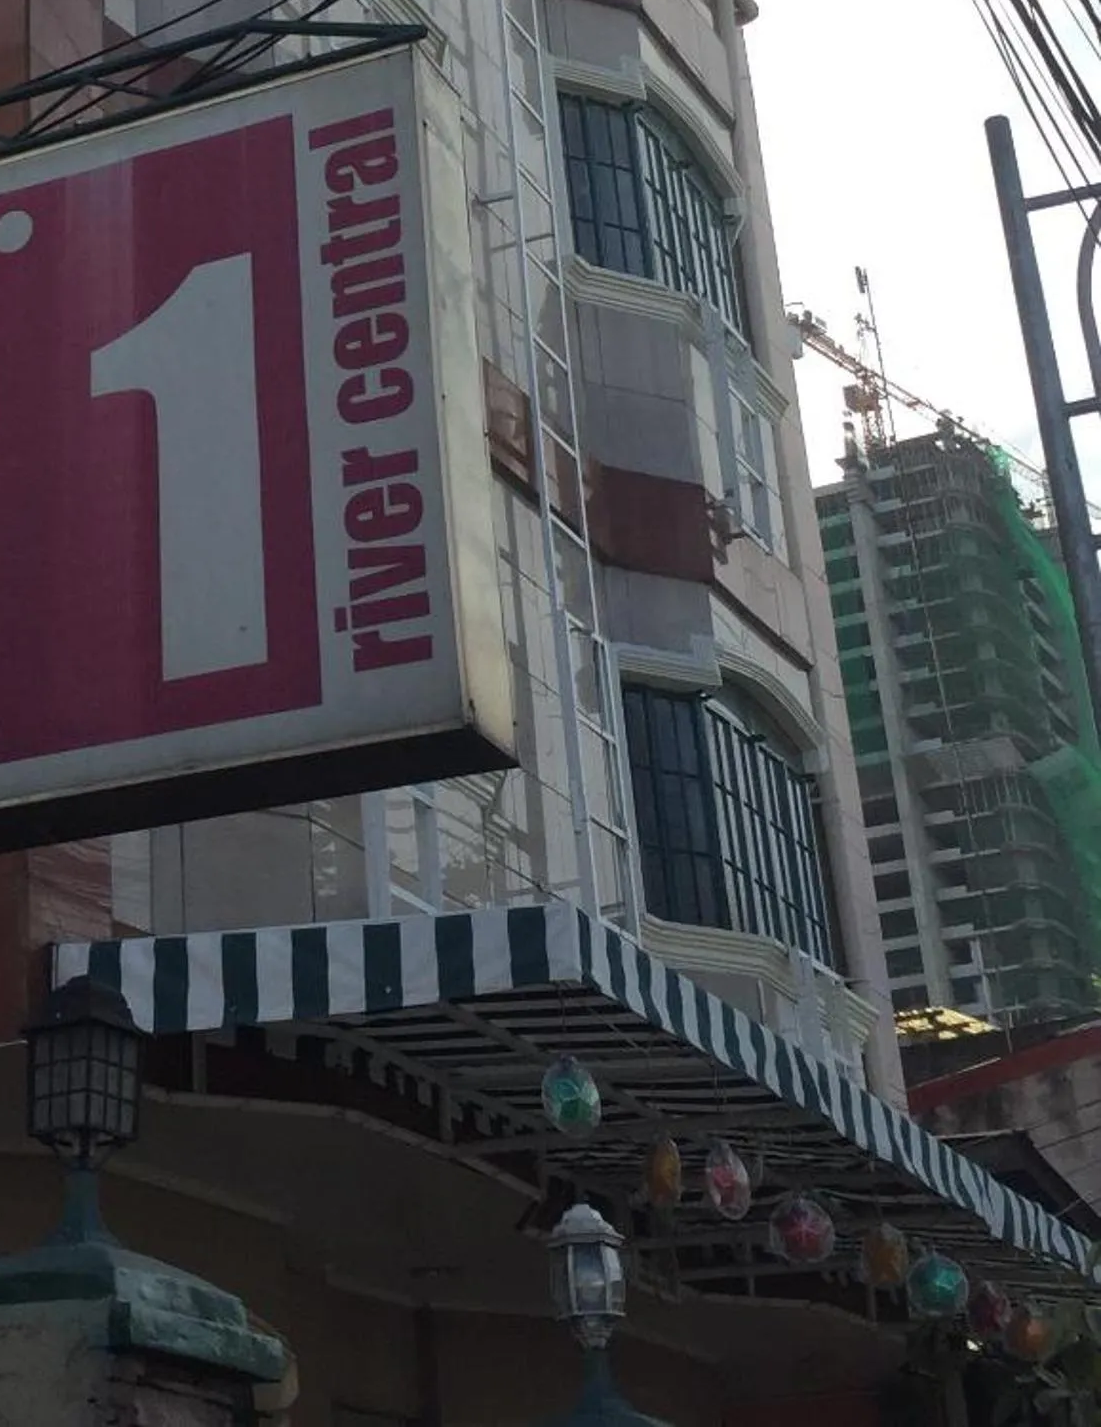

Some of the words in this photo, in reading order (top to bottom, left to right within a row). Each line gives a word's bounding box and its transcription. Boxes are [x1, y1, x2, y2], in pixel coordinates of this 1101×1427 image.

[309, 107, 414, 425] central
[91, 253, 268, 681] 1
[334, 446, 433, 672] river
